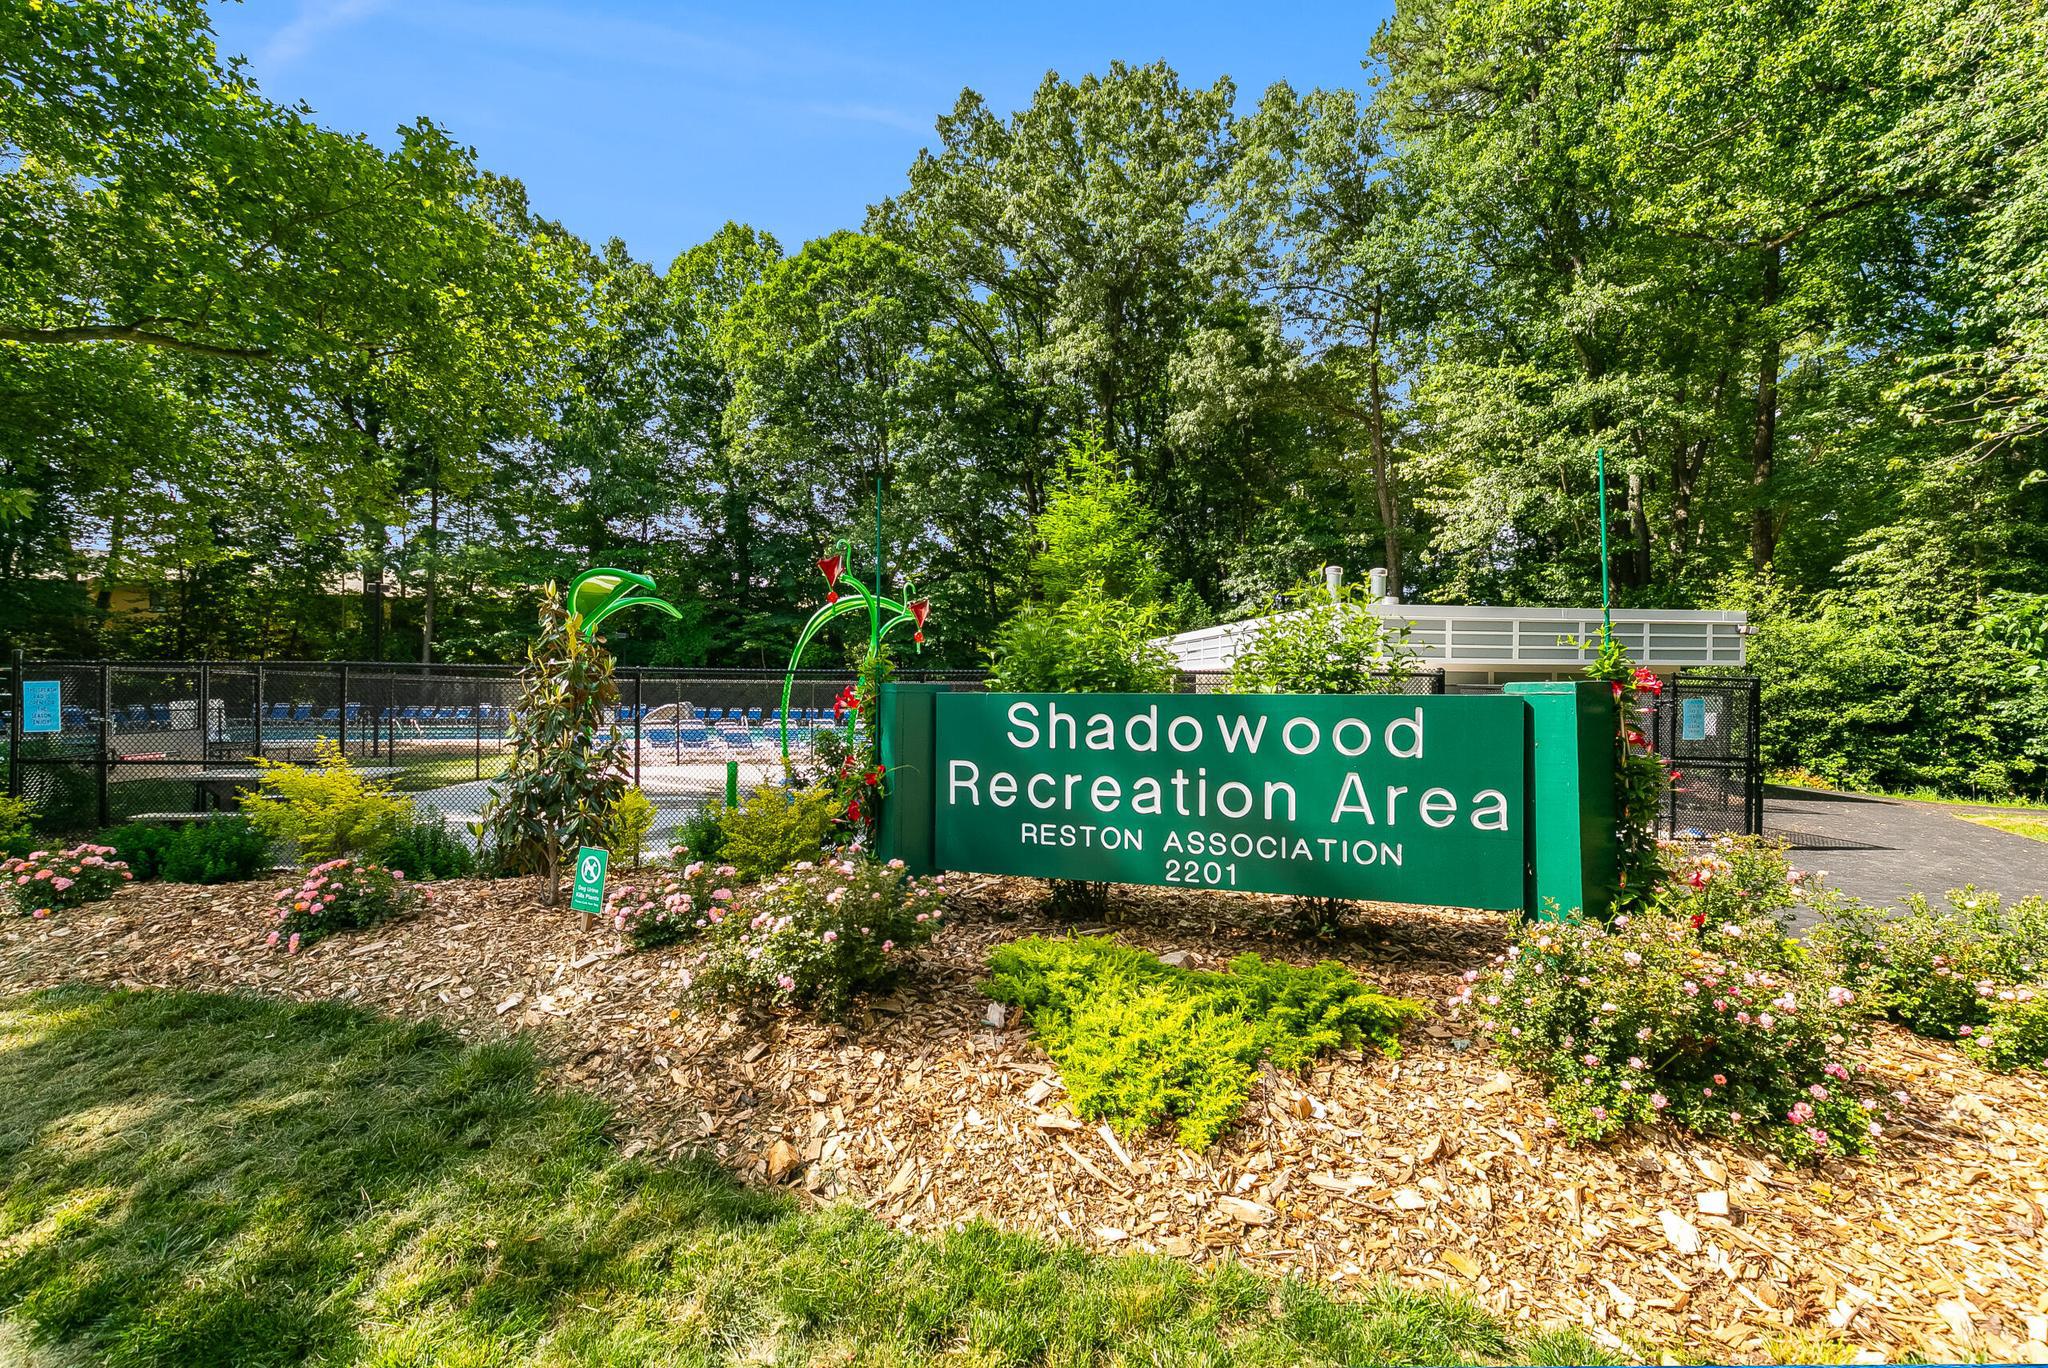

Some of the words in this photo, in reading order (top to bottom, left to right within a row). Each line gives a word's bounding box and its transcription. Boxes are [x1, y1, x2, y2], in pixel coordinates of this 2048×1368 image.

[1006, 701, 1424, 759] Shadowood
[949, 759, 1297, 822] Recreation
[1330, 771, 1509, 832] Area
[1021, 822, 1143, 851] RESTON
[1162, 830, 1403, 867] ASSOCIATION
[577, 884, 587, 892] Dog
[1165, 858, 1236, 886] 2201
